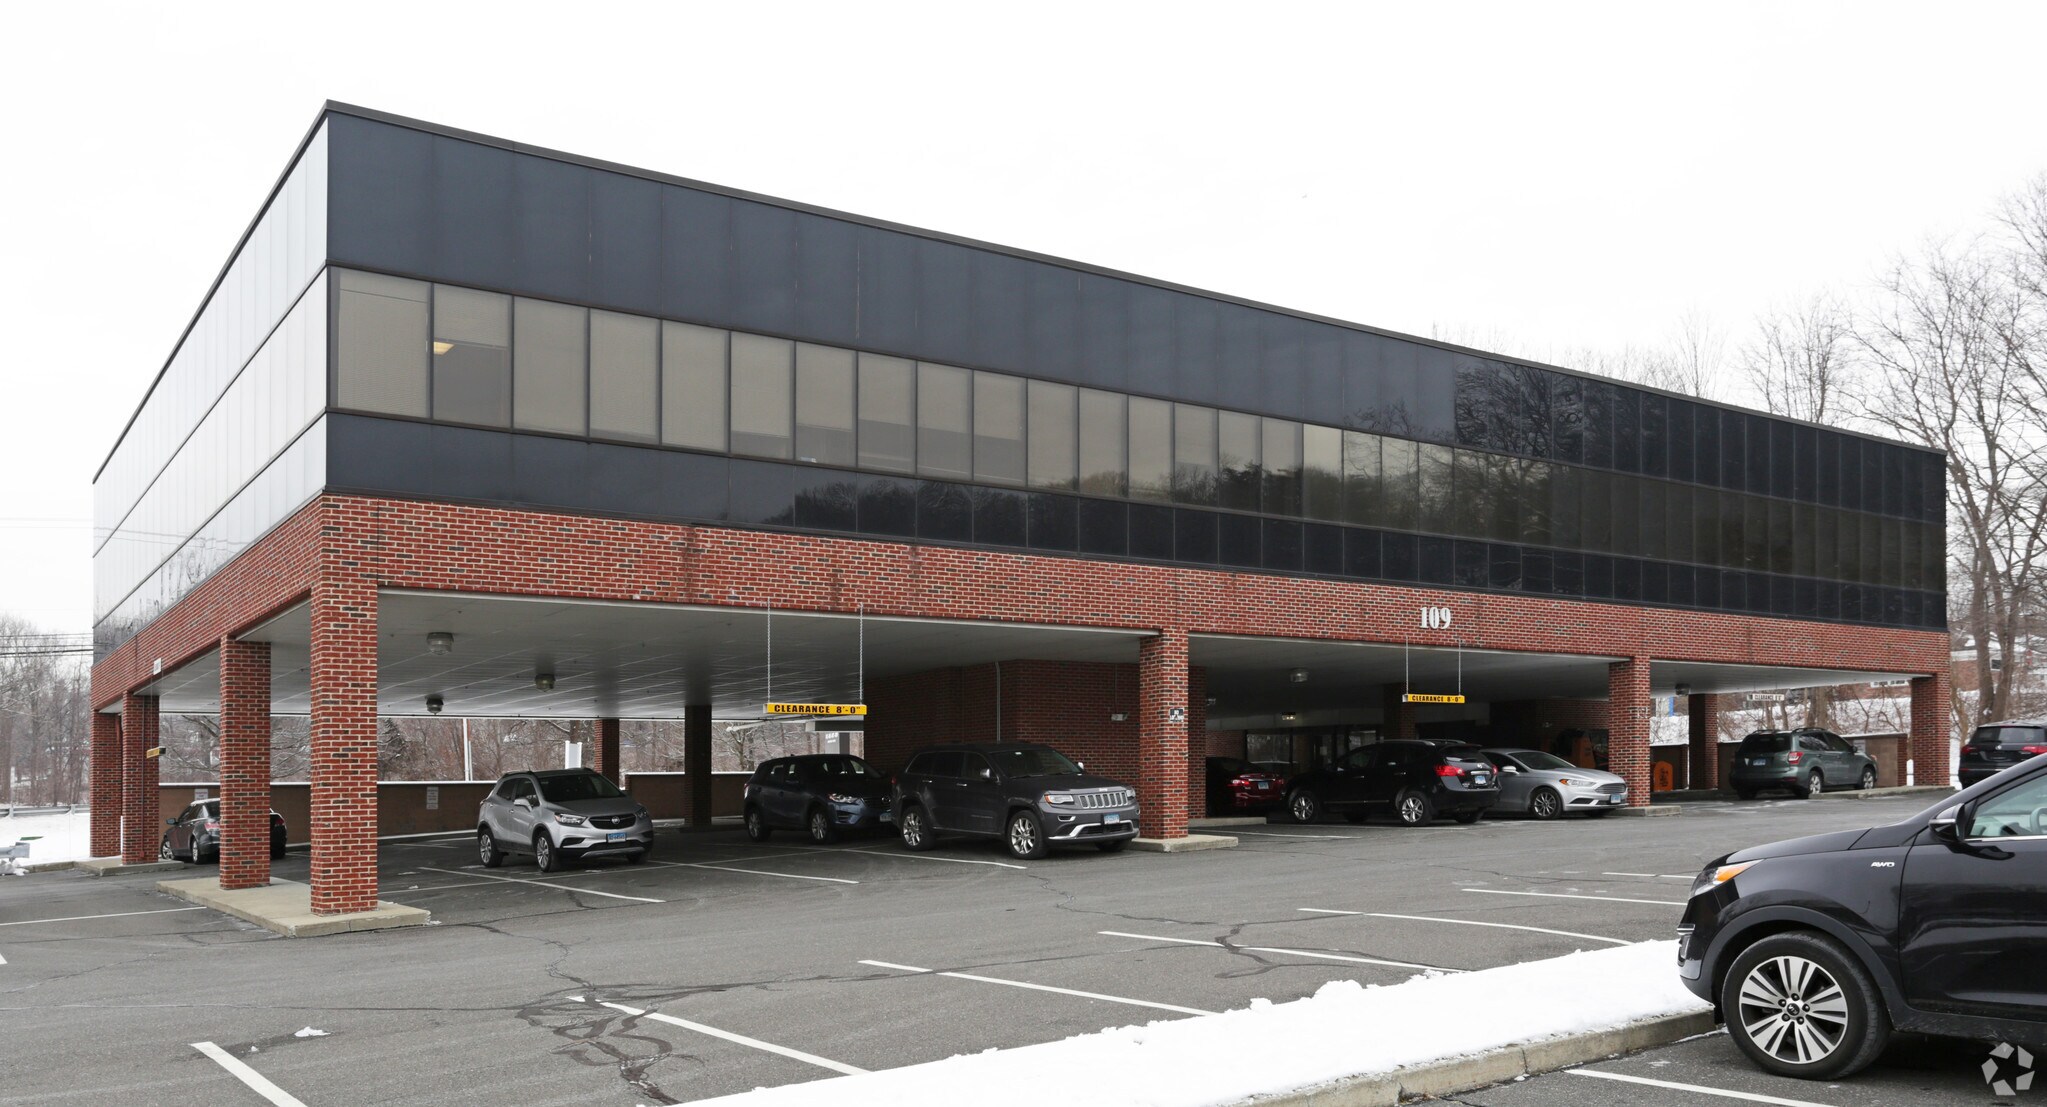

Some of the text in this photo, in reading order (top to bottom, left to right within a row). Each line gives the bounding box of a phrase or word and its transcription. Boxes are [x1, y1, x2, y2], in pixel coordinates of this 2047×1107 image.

[1420, 606, 1451, 629] 109
[774, 704, 861, 714] CLEARANCE 8'-0"
